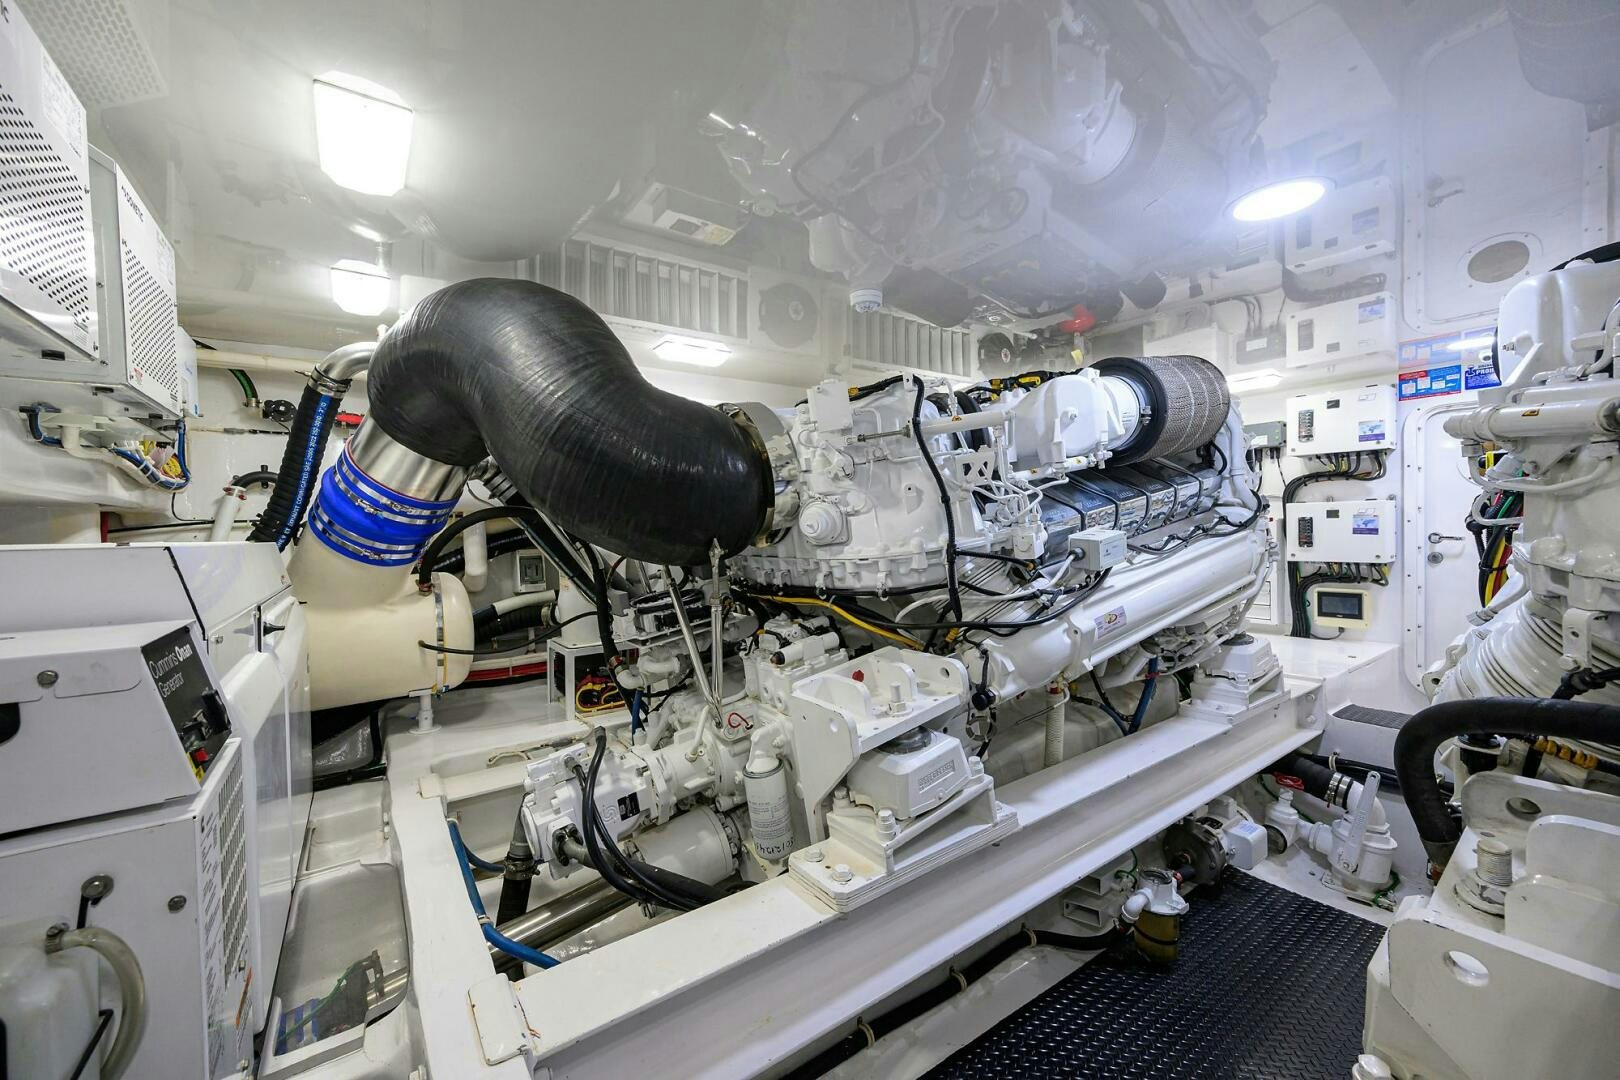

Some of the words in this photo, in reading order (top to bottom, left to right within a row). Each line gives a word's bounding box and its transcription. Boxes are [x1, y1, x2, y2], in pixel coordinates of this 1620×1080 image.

[149, 652, 178, 679] Cummins
[175, 643, 193, 661] Onan
[158, 672, 184, 697] Generator
